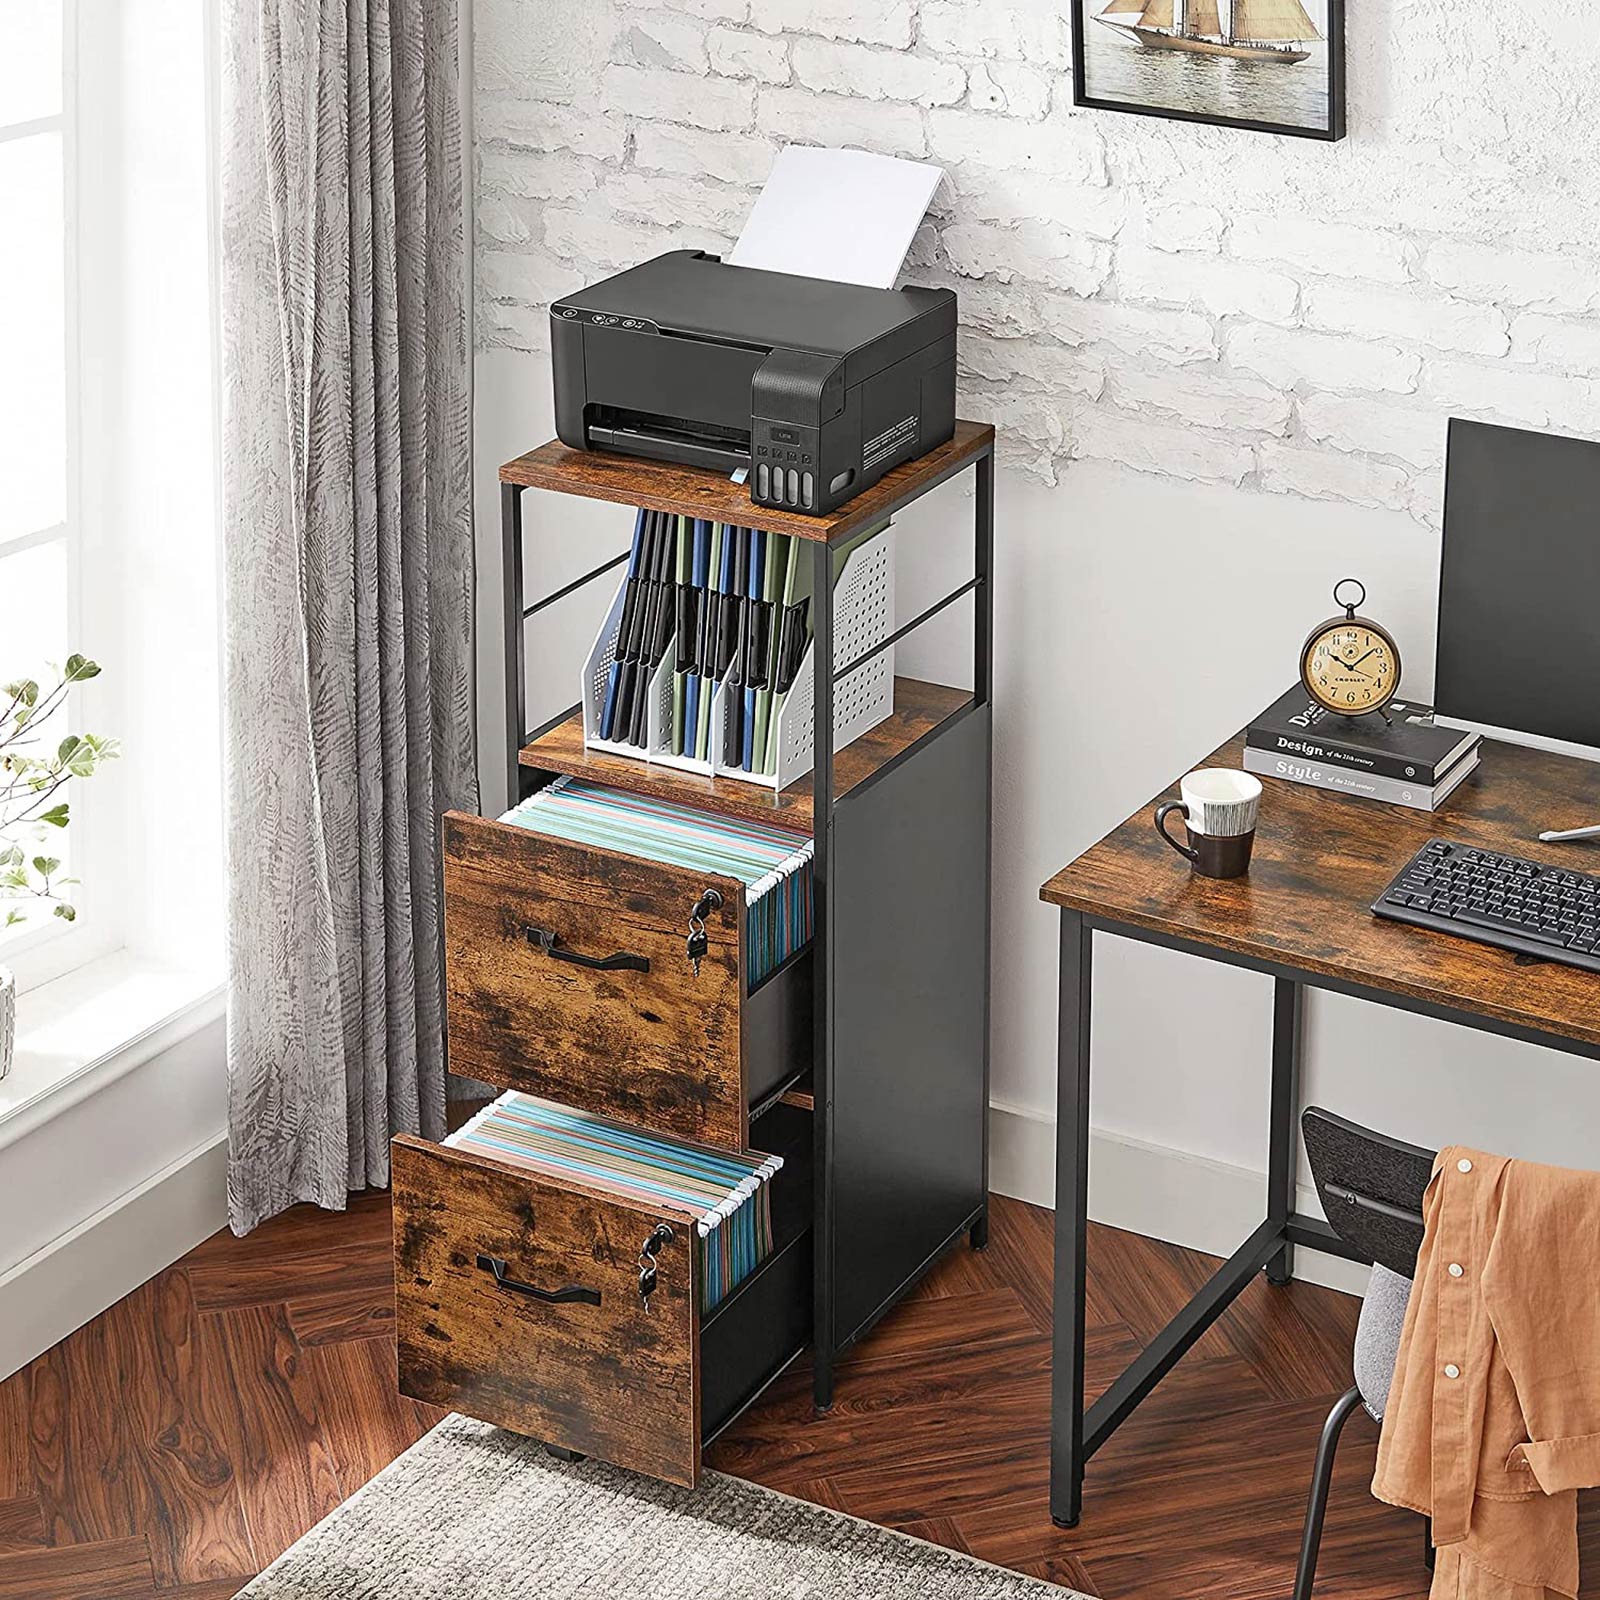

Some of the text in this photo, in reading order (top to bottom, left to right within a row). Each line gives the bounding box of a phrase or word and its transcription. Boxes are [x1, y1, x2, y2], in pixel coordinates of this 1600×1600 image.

[1333, 634, 1340, 645] 11
[1347, 632, 1357, 642] 12
[1319, 646, 1329, 656] 10
[1375, 647, 1383, 658] 2
[1314, 660, 1322, 671] 9
[1379, 662, 1387, 673] 3
[1319, 675, 1328, 686] 8
[1373, 677, 1383, 688] 4
[1330, 687, 1338, 697] 7
[1346, 691, 1355, 702] 6
[1362, 689, 1371, 699] 5
[1277, 737, 1323, 756] Design
[1276, 760, 1321, 780] Style
